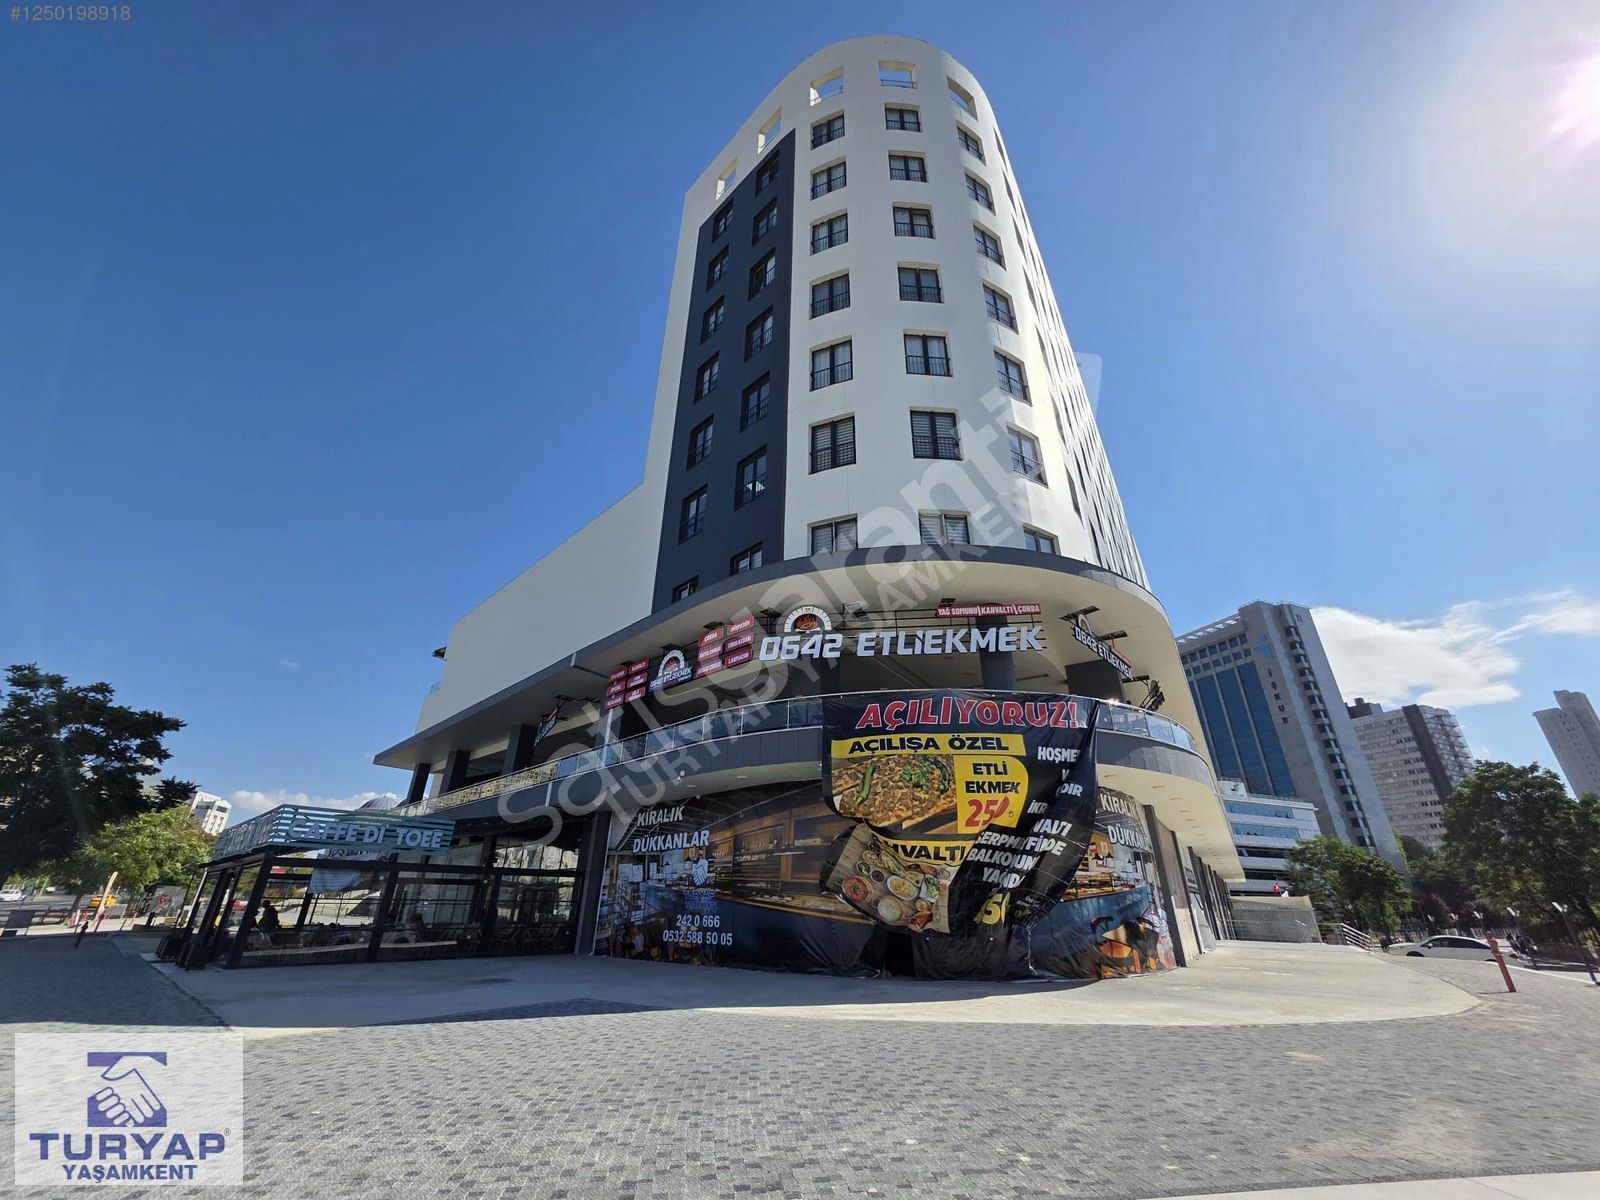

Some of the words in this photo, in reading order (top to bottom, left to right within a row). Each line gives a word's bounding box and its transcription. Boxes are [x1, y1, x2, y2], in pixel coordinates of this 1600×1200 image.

[759, 634, 843, 661] 0642
[855, 697, 1081, 730] AÇILIYORUZ!
[848, 736, 941, 755] AÇILIŞA
[948, 734, 1009, 751] ÖZEL
[1037, 746, 1080, 763] HOŞME
[972, 762, 1008, 776] ETLİ
[965, 780, 1021, 794] EKMEK
[288, 818, 360, 842] CAFFE
[632, 830, 710, 853] DÜKKANLAR
[676, 914, 692, 927] 242
[694, 915, 700, 927] 0
[702, 915, 720, 928] 666
[663, 930, 684, 942] 0532
[686, 931, 702, 944] 588
[706, 932, 718, 945] 50
[720, 933, 733, 945] 05
